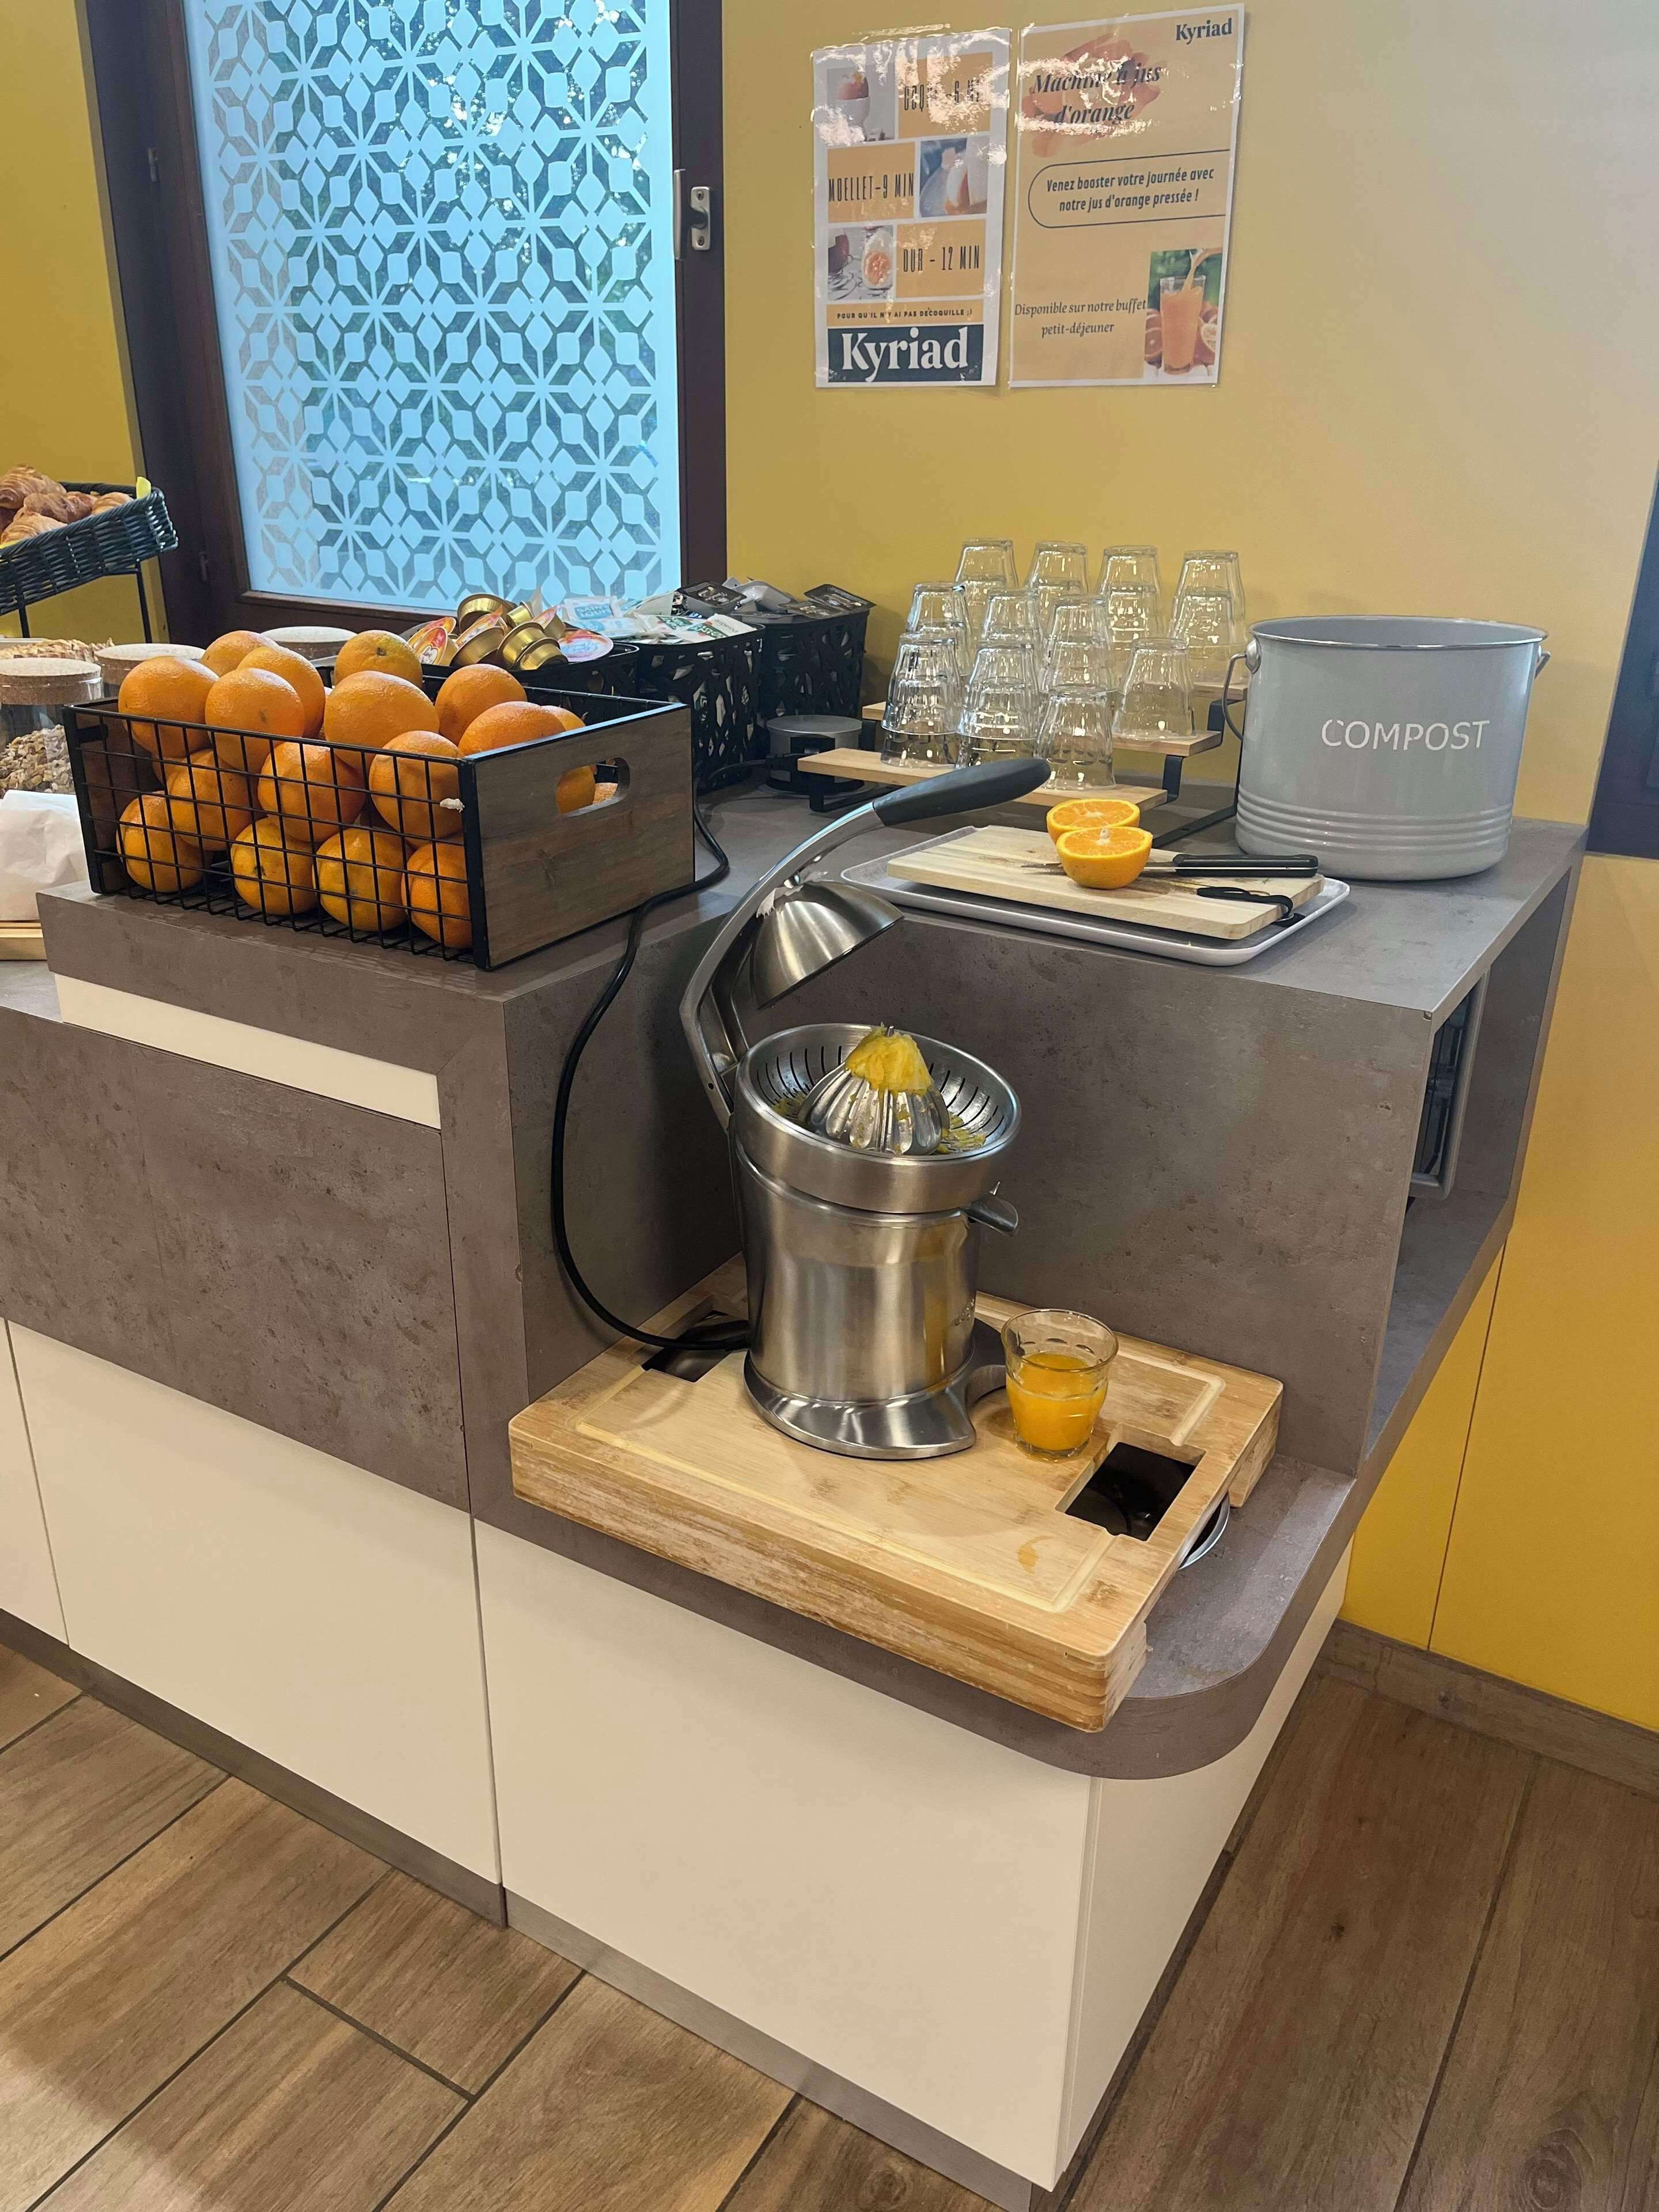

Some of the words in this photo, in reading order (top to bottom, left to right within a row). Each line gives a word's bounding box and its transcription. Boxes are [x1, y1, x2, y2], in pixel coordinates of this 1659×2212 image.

[1176, 18, 1232, 44] Kyriad
[1130, 63, 1162, 89] jus
[1054, 104, 1134, 125] d'orange
[895, 173, 914, 198] MIN
[1047, 179, 1074, 192] Venez
[1077, 176, 1115, 190] booster
[1118, 173, 1144, 187] votre
[1146, 167, 1187, 188] journée
[1190, 168, 1214, 181] avec
[1059, 198, 1086, 212] notre
[1088, 197, 1102, 213] jus
[1105, 194, 1151, 209] d'orange
[1153, 189, 1192, 209] pressée
[903, 248, 922, 272] DUR
[942, 247, 953, 271] 12
[960, 245, 979, 270] MIN
[1014, 301, 1067, 318] Disponible
[1069, 304, 1085, 313] sur
[1087, 302, 1114, 312] notre
[1116, 298, 1146, 314] buffet
[1041, 322, 1115, 338] petit-déjeuner
[841, 326, 968, 382] Kyriad
[1321, 719, 1490, 751] COMPOST
